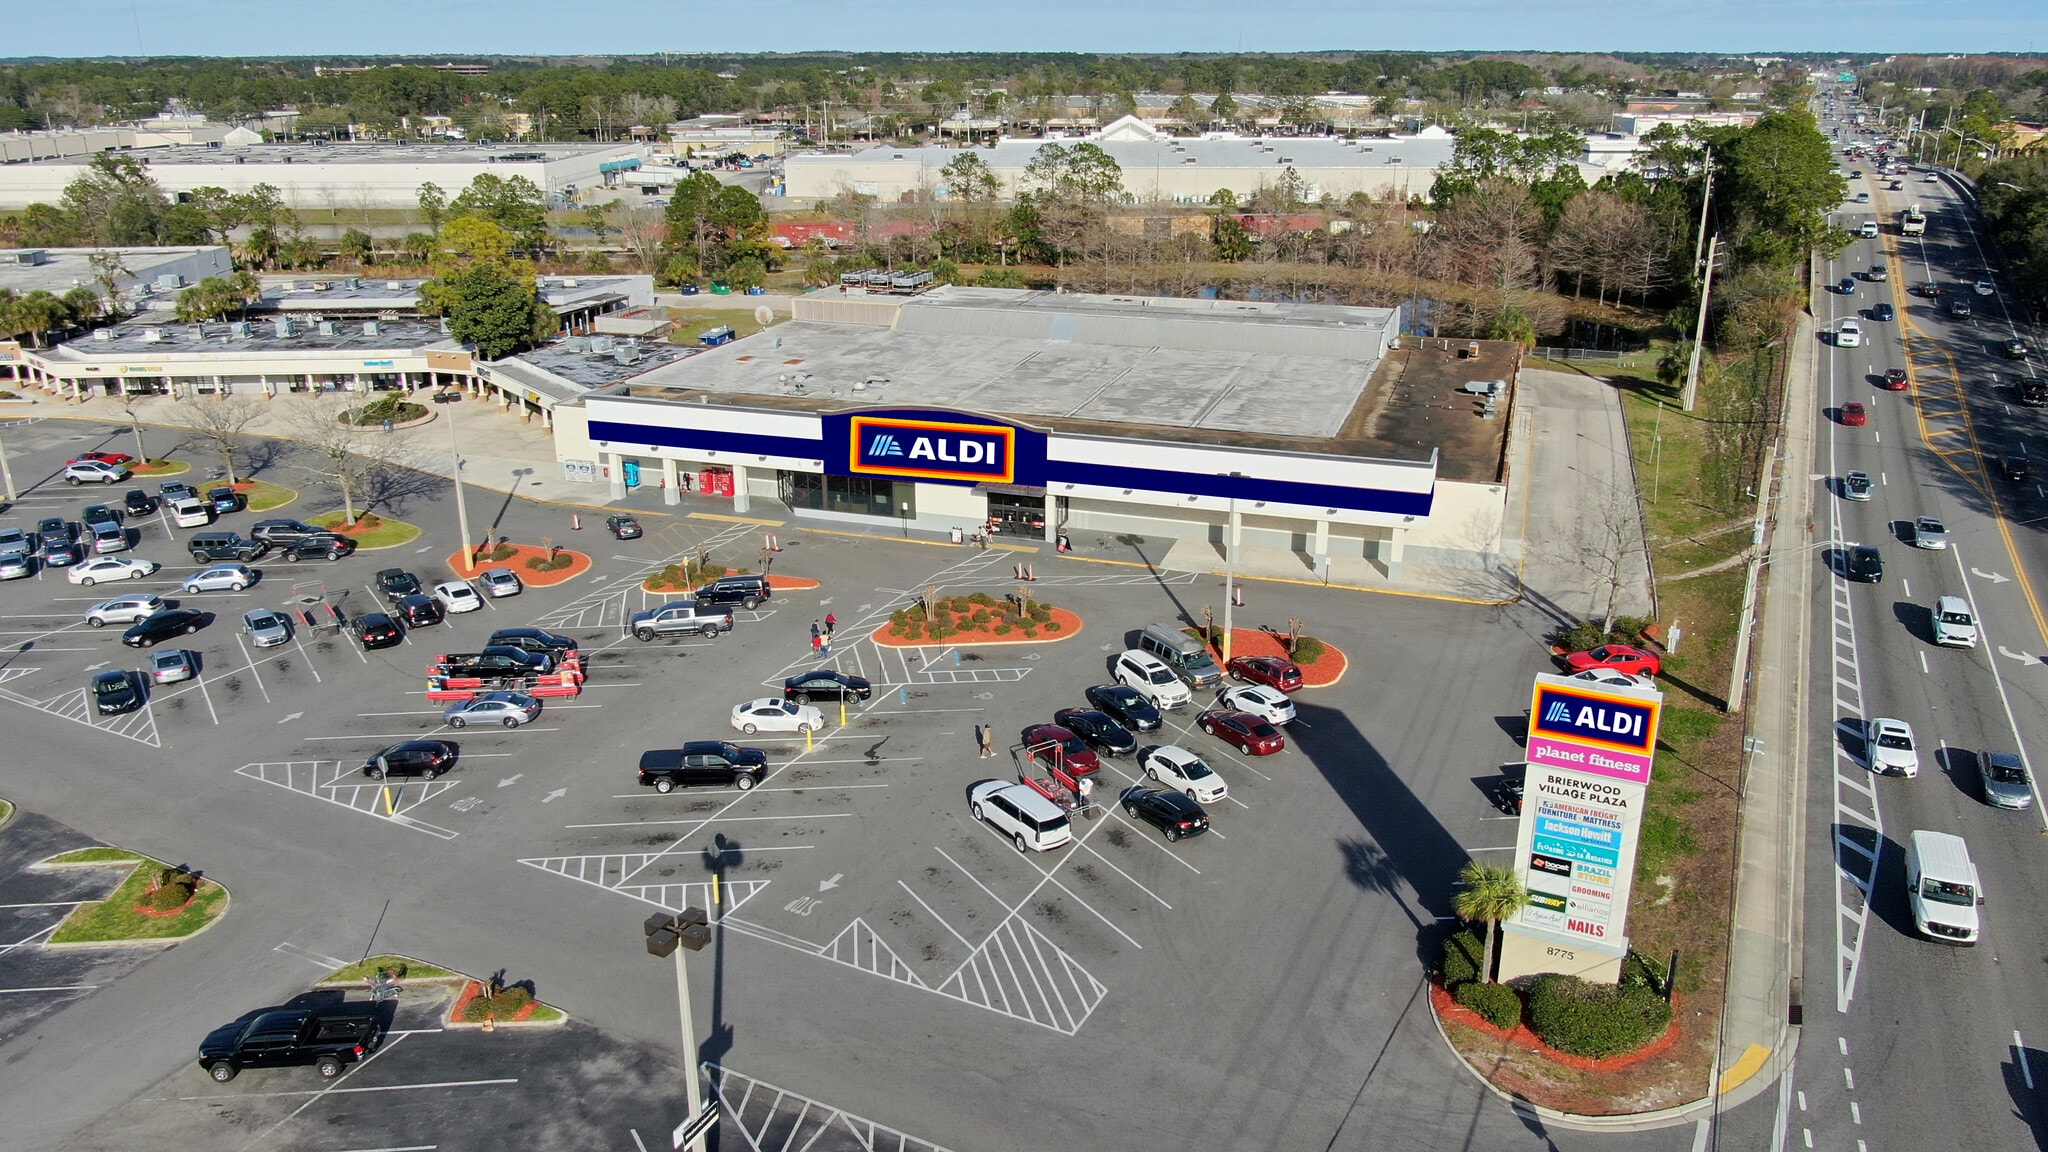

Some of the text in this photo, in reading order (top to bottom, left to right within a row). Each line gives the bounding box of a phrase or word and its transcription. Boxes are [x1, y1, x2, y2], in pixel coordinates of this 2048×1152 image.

[909, 437, 996, 465] ALDI
[1575, 705, 1643, 737] ALDI
[1535, 745, 1641, 774] planet fitness
[1539, 783, 1628, 808] VILLAGE PLAZA
[1547, 775, 1621, 796] BRIERWOOD
[1537, 806, 1578, 821] FURNITURE
[1583, 815, 1622, 830] MATTRESS
[1553, 803, 1619, 821] AMERICAN FREIGHT
[1543, 819, 1612, 843] Jackson Hewitt
[1577, 864, 1612, 878] BRAZIL
[1577, 872, 1610, 885] STORE
[1531, 894, 1565, 907] SUBWAY
[1571, 885, 1611, 900] GROOMING
[1576, 903, 1609, 916] ellianos
[1567, 918, 1605, 938] NAILS
[1546, 946, 1574, 961] 8775
